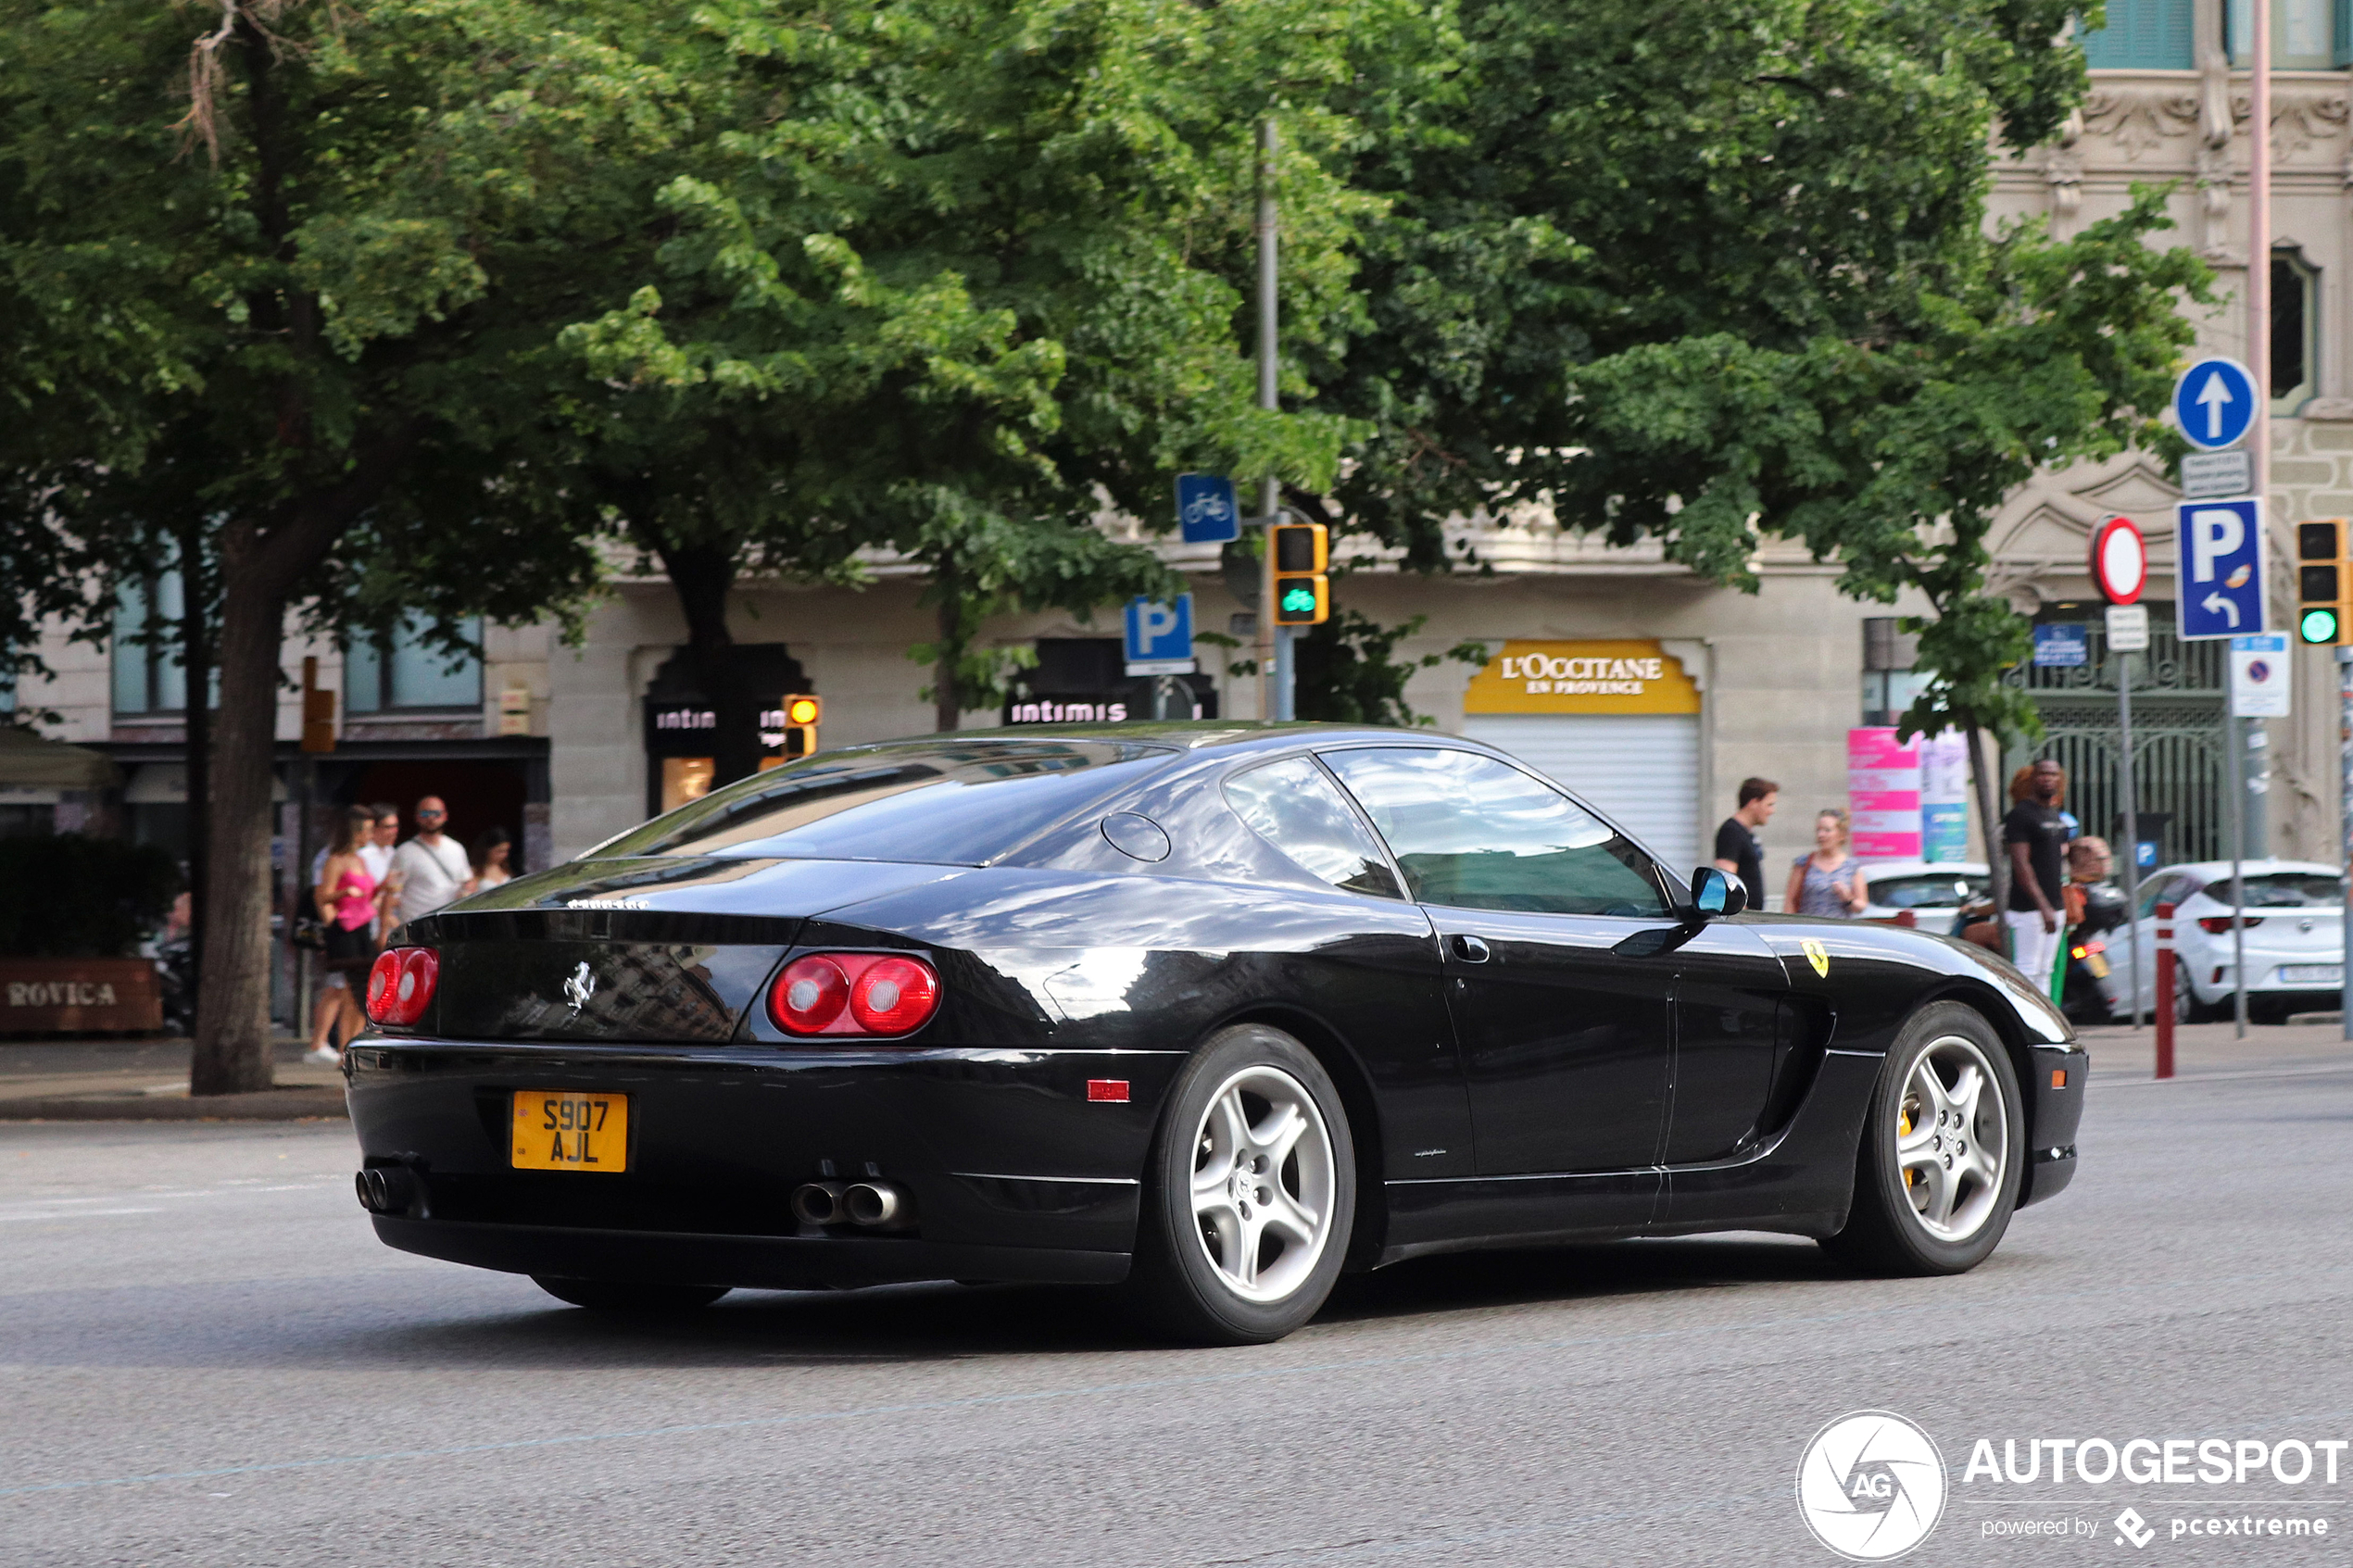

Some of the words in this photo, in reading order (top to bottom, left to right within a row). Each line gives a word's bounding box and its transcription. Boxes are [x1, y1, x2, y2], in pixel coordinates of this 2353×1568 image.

[2191, 508, 2246, 583] P
[1138, 602, 1178, 654] P
[1526, 681, 1552, 695] EN
[1554, 681, 1644, 696] PROVENCE
[8, 982, 117, 1007] ROVICA
[544, 1099, 609, 1132] S907
[550, 1131, 598, 1163] AJL
